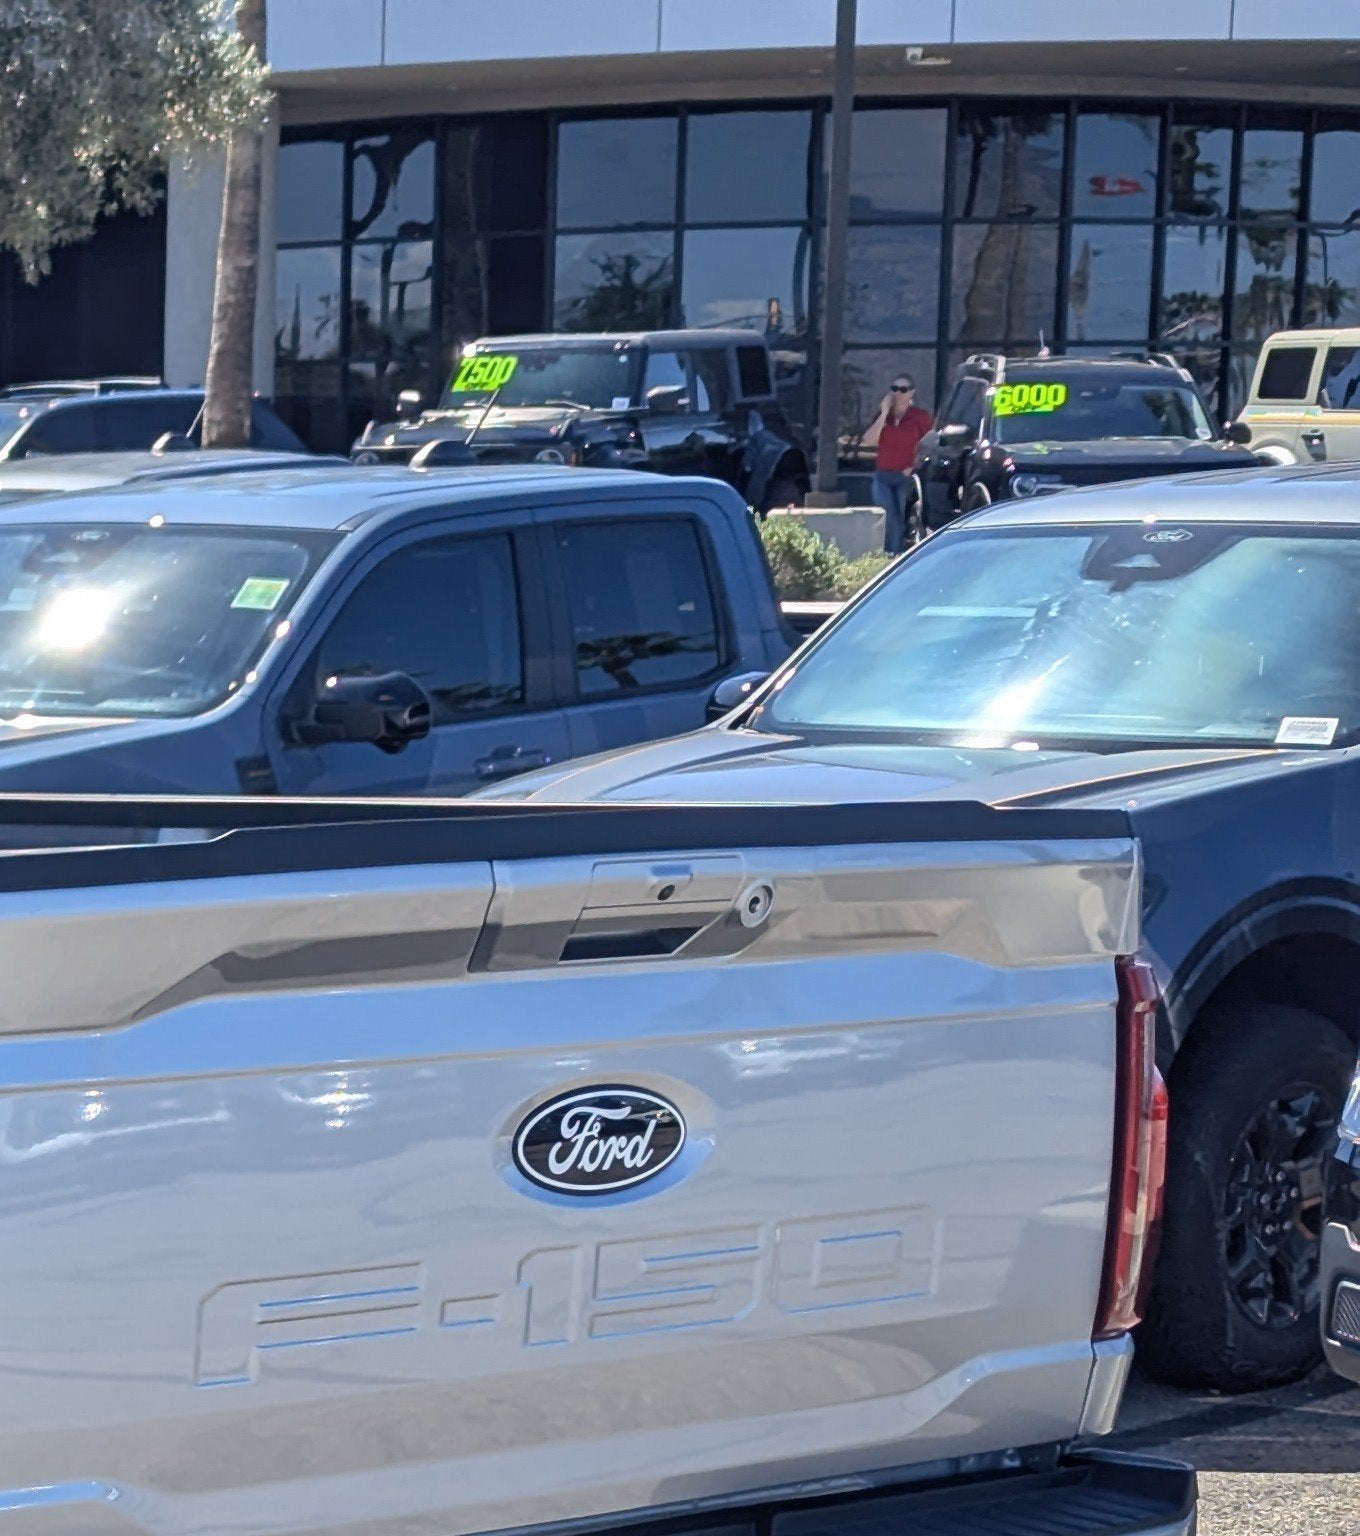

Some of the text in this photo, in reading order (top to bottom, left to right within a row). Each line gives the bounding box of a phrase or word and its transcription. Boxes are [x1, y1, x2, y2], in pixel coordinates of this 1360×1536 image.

[458, 356, 518, 384] 7500
[995, 384, 1067, 406] 6000
[548, 1106, 657, 1175] Ford
[193, 1203, 943, 1387] F-150
